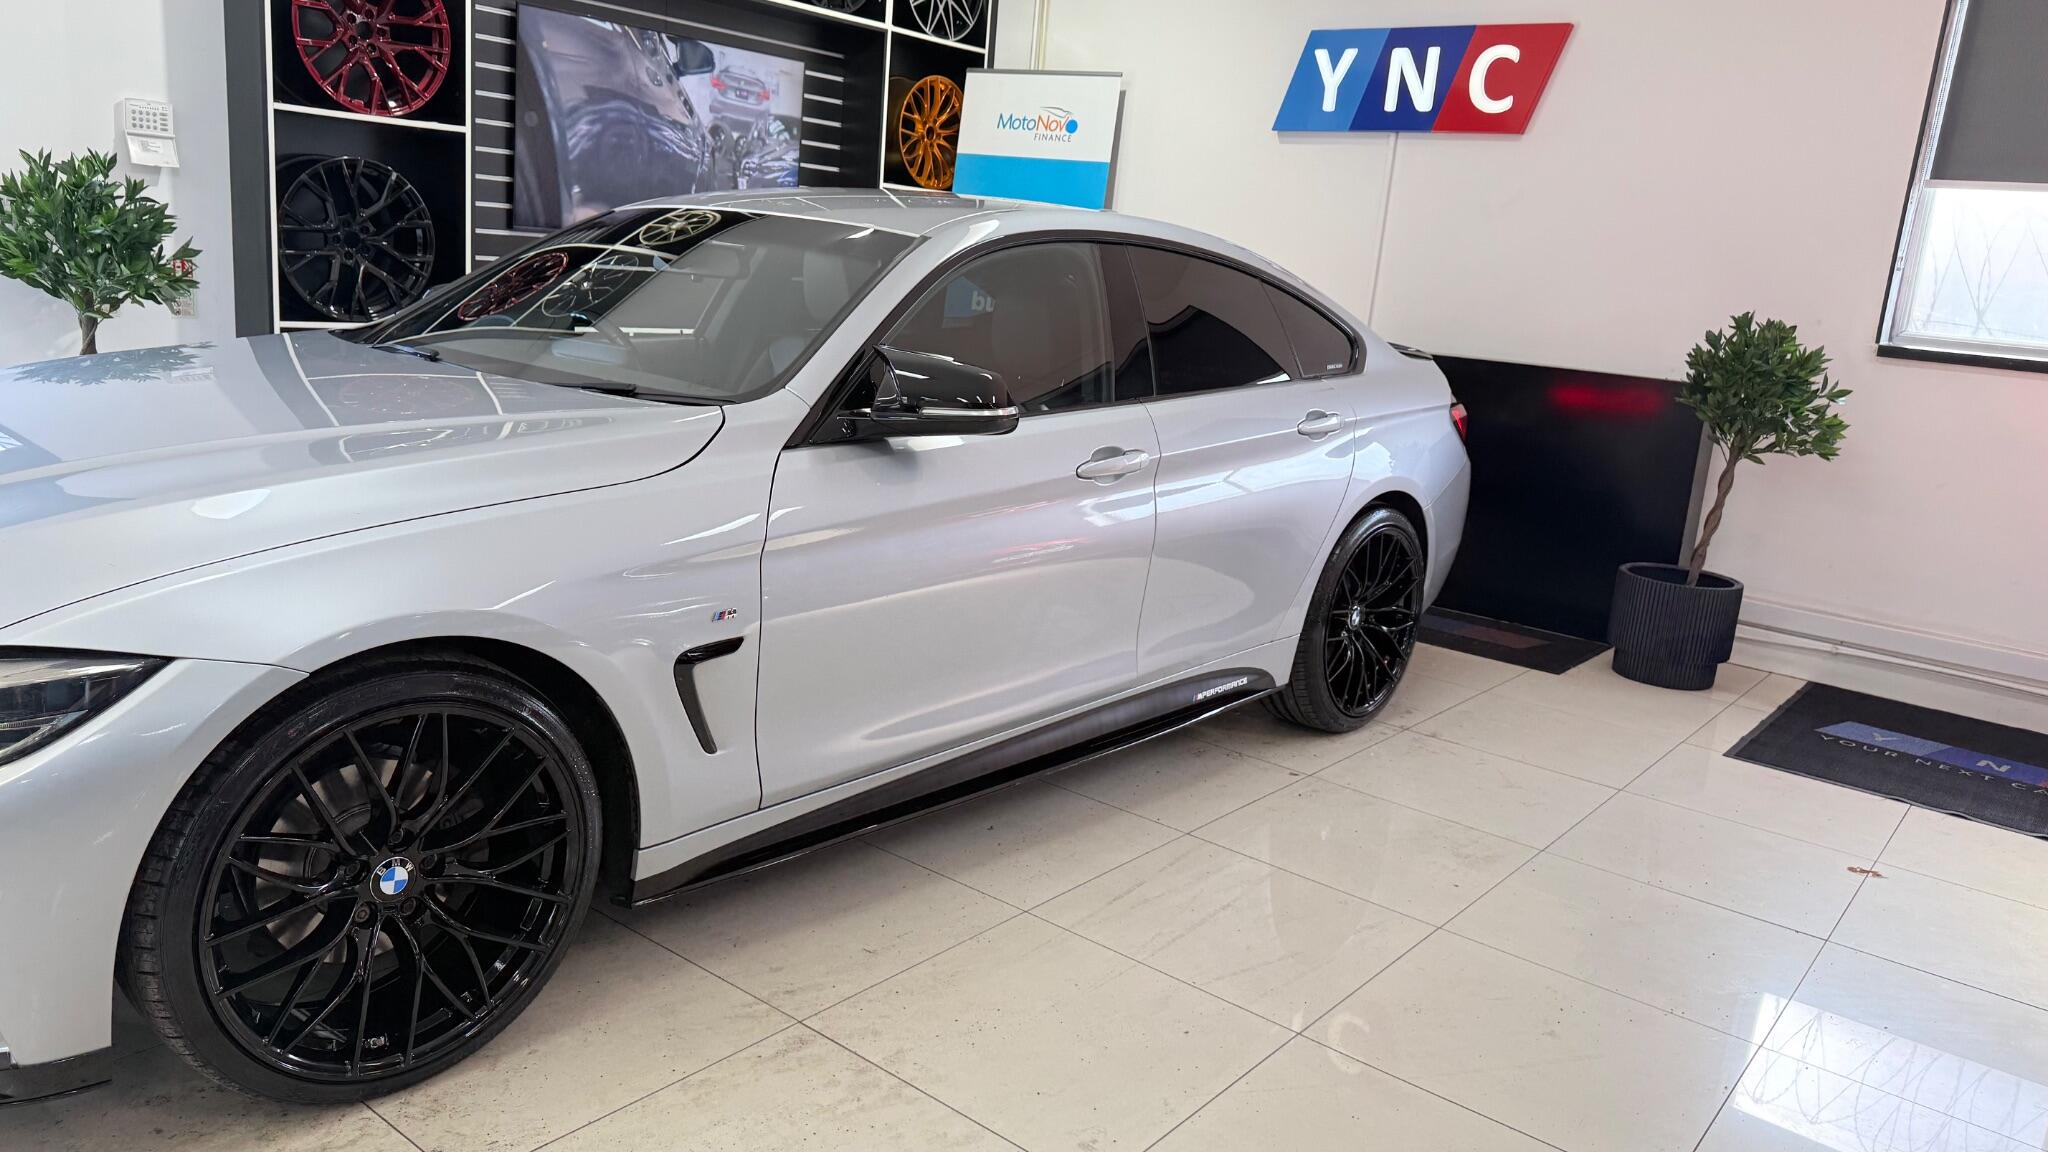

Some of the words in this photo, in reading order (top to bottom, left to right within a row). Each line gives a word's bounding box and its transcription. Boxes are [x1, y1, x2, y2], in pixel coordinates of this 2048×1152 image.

[1314, 44, 1521, 114] YNC
[1033, 133, 1073, 143] FINANCE
[1820, 734, 1898, 758] YOUR
[1915, 758, 1995, 781] NEXT
